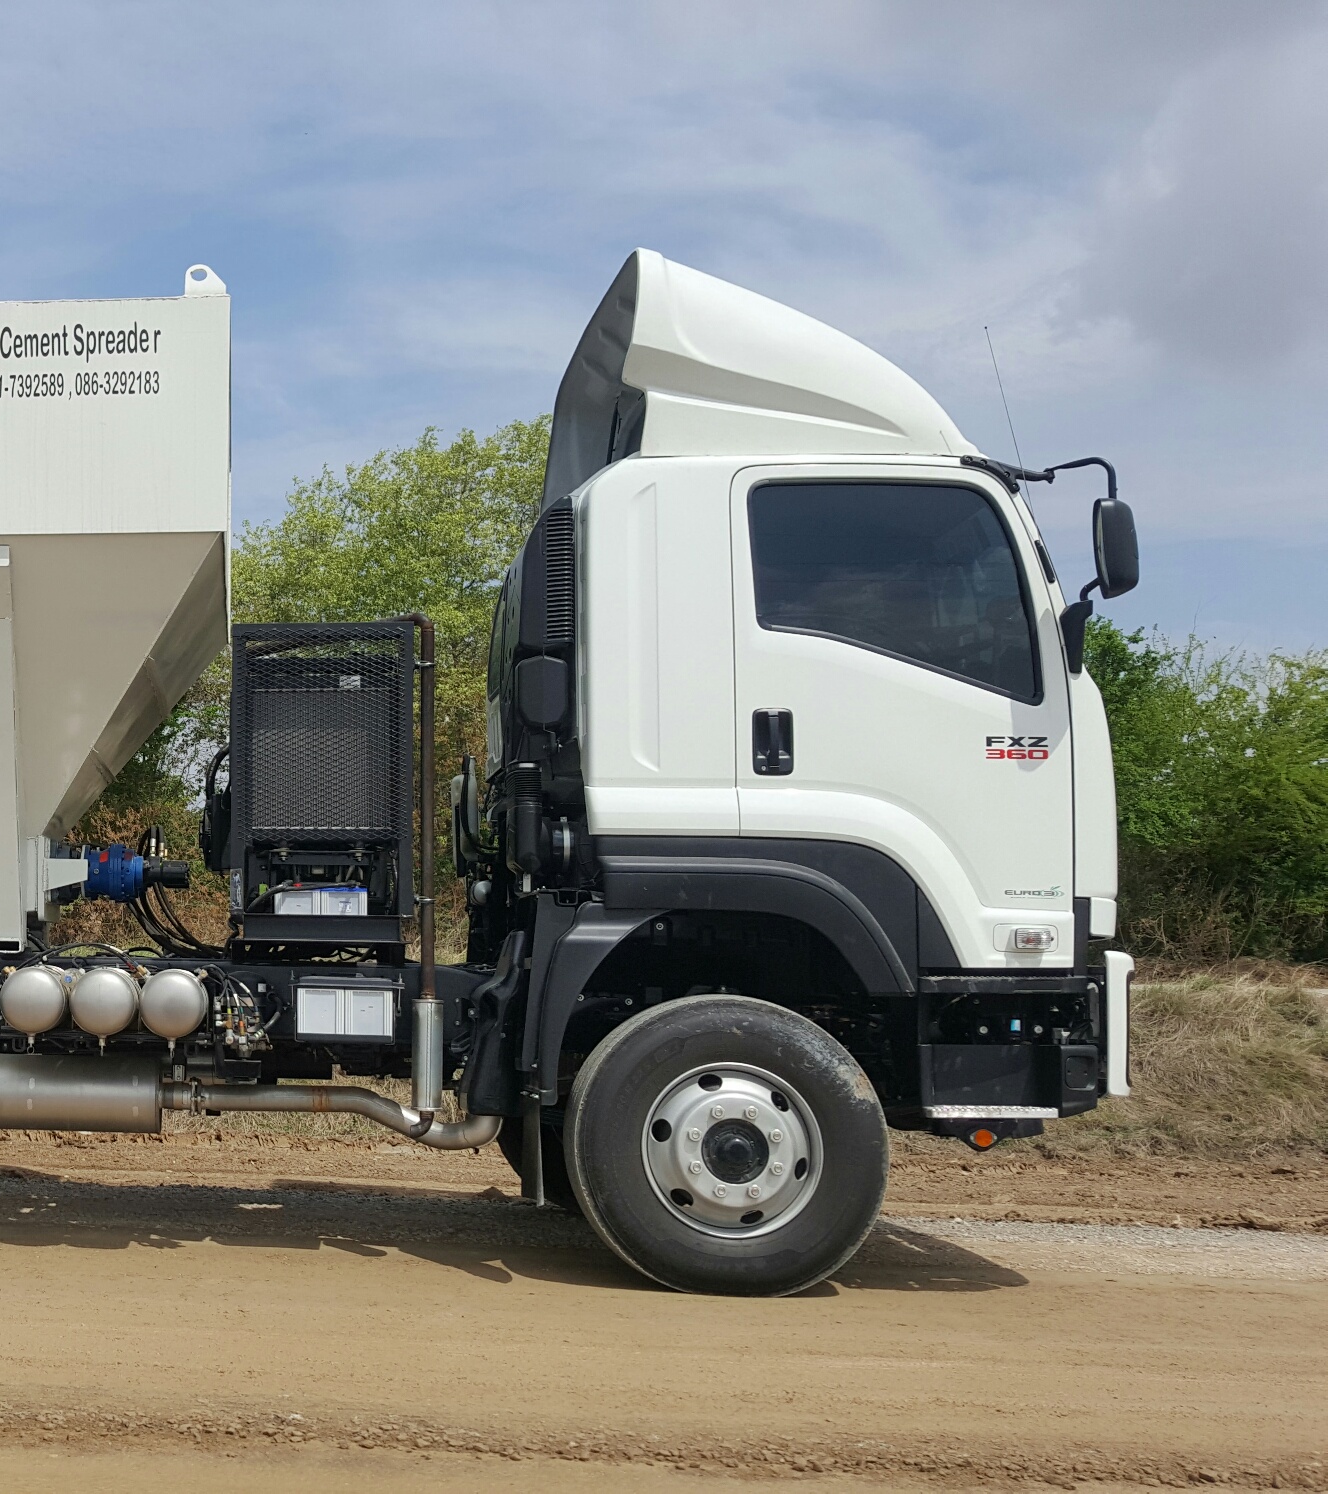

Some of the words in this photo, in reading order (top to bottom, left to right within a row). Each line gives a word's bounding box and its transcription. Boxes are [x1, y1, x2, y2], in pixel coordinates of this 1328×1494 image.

[0, 325, 69, 359] Cement
[74, 321, 161, 363] Spreader
[986, 736, 1049, 747] FXZ
[986, 749, 1049, 760] 360
